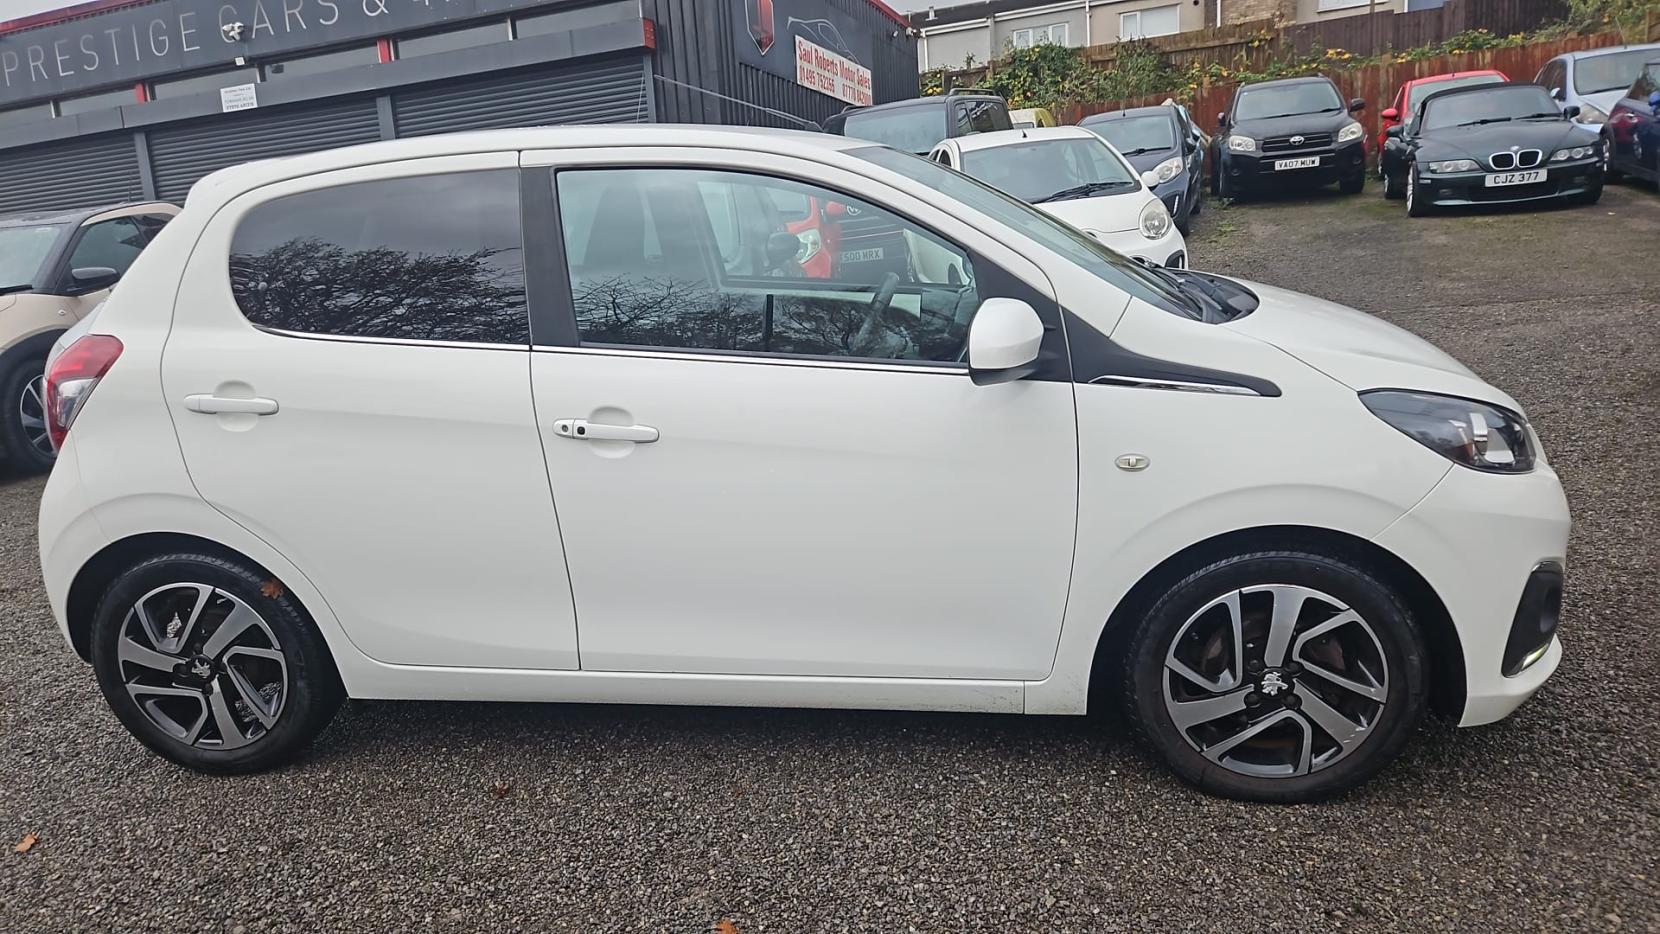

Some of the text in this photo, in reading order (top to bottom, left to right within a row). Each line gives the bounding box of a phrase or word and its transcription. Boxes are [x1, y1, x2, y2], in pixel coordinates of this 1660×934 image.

[2, 12, 201, 87] PRESTIGE
[219, 0, 339, 43] CARS
[798, 40, 871, 90] Saul Roberts Motor Sales
[1279, 160, 1299, 169] VA07
[1493, 171, 1540, 185] CJZ 377
[862, 249, 880, 261] MRX
